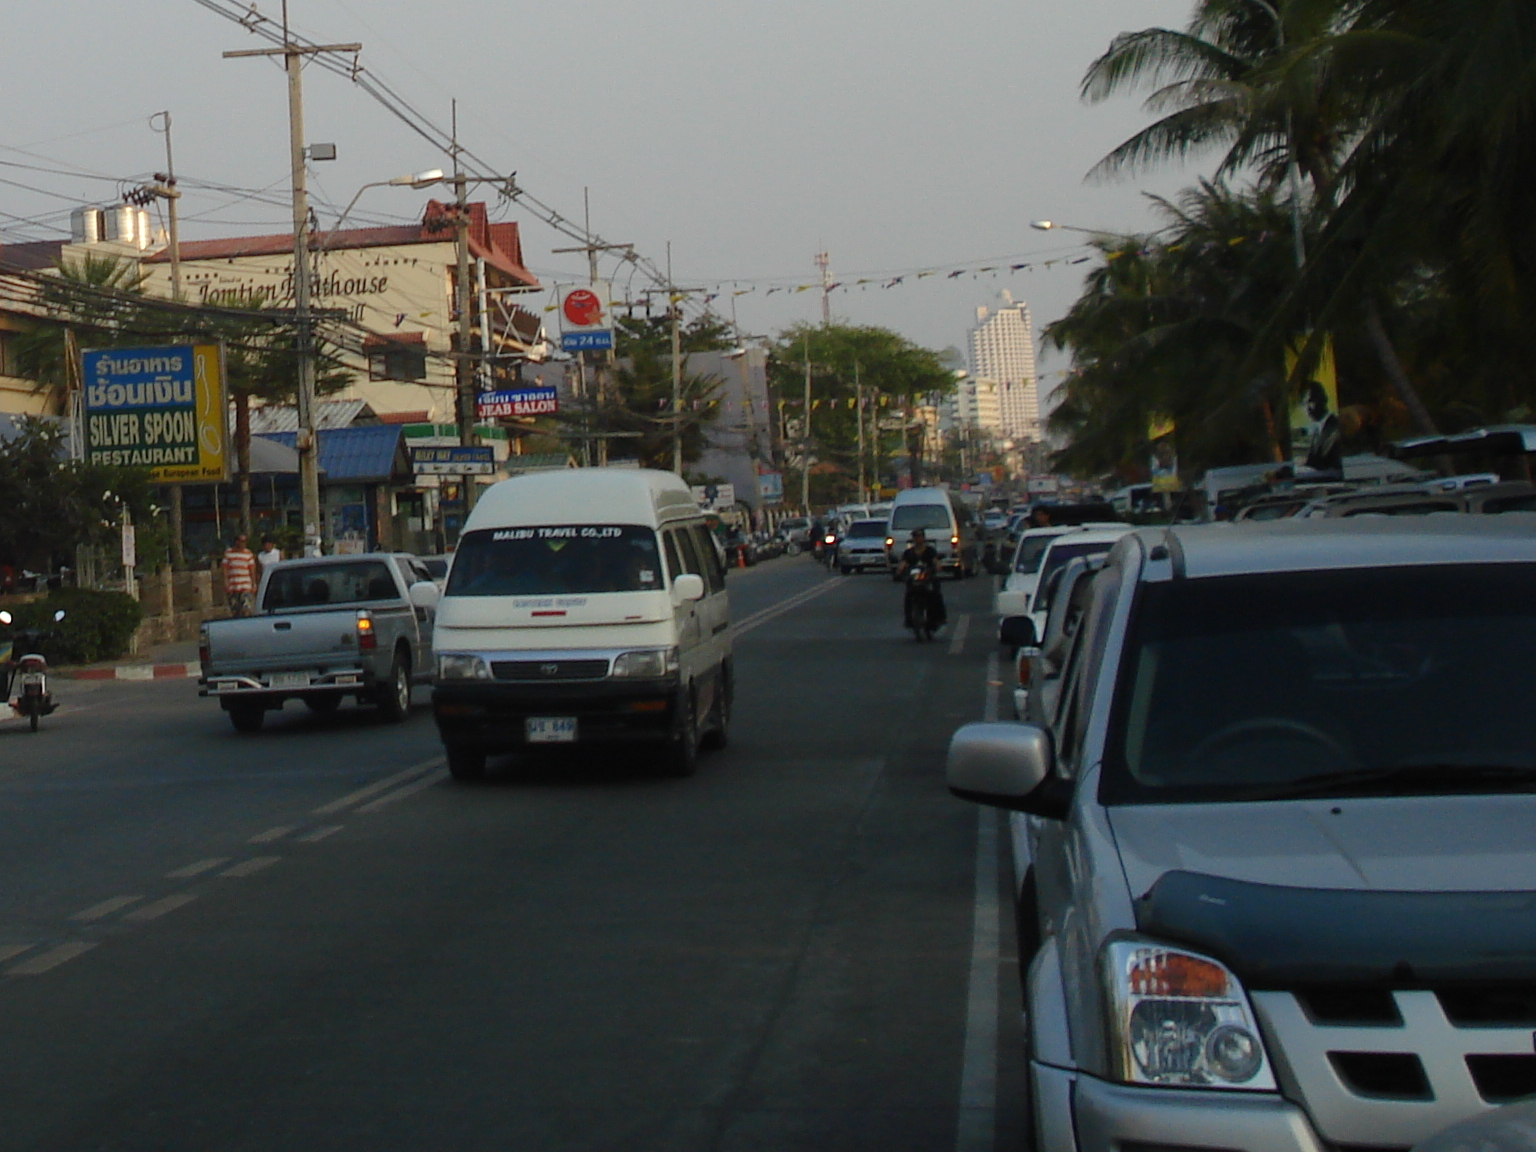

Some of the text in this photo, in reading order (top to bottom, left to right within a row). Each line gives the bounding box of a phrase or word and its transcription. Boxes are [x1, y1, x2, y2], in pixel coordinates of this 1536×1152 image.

[579, 335, 594, 347] 24
[95, 354, 183, 376] ร้านอาหาร
[87, 376, 193, 407] ช้อนเงิน
[478, 399, 556, 417] JEAB SALON
[90, 411, 194, 447] SILVER SPOON
[91, 447, 195, 466] RESTAURANT
[202, 466, 221, 476] Food
[492, 529, 534, 541] MALIBU
[538, 528, 577, 538] TRAVEL
